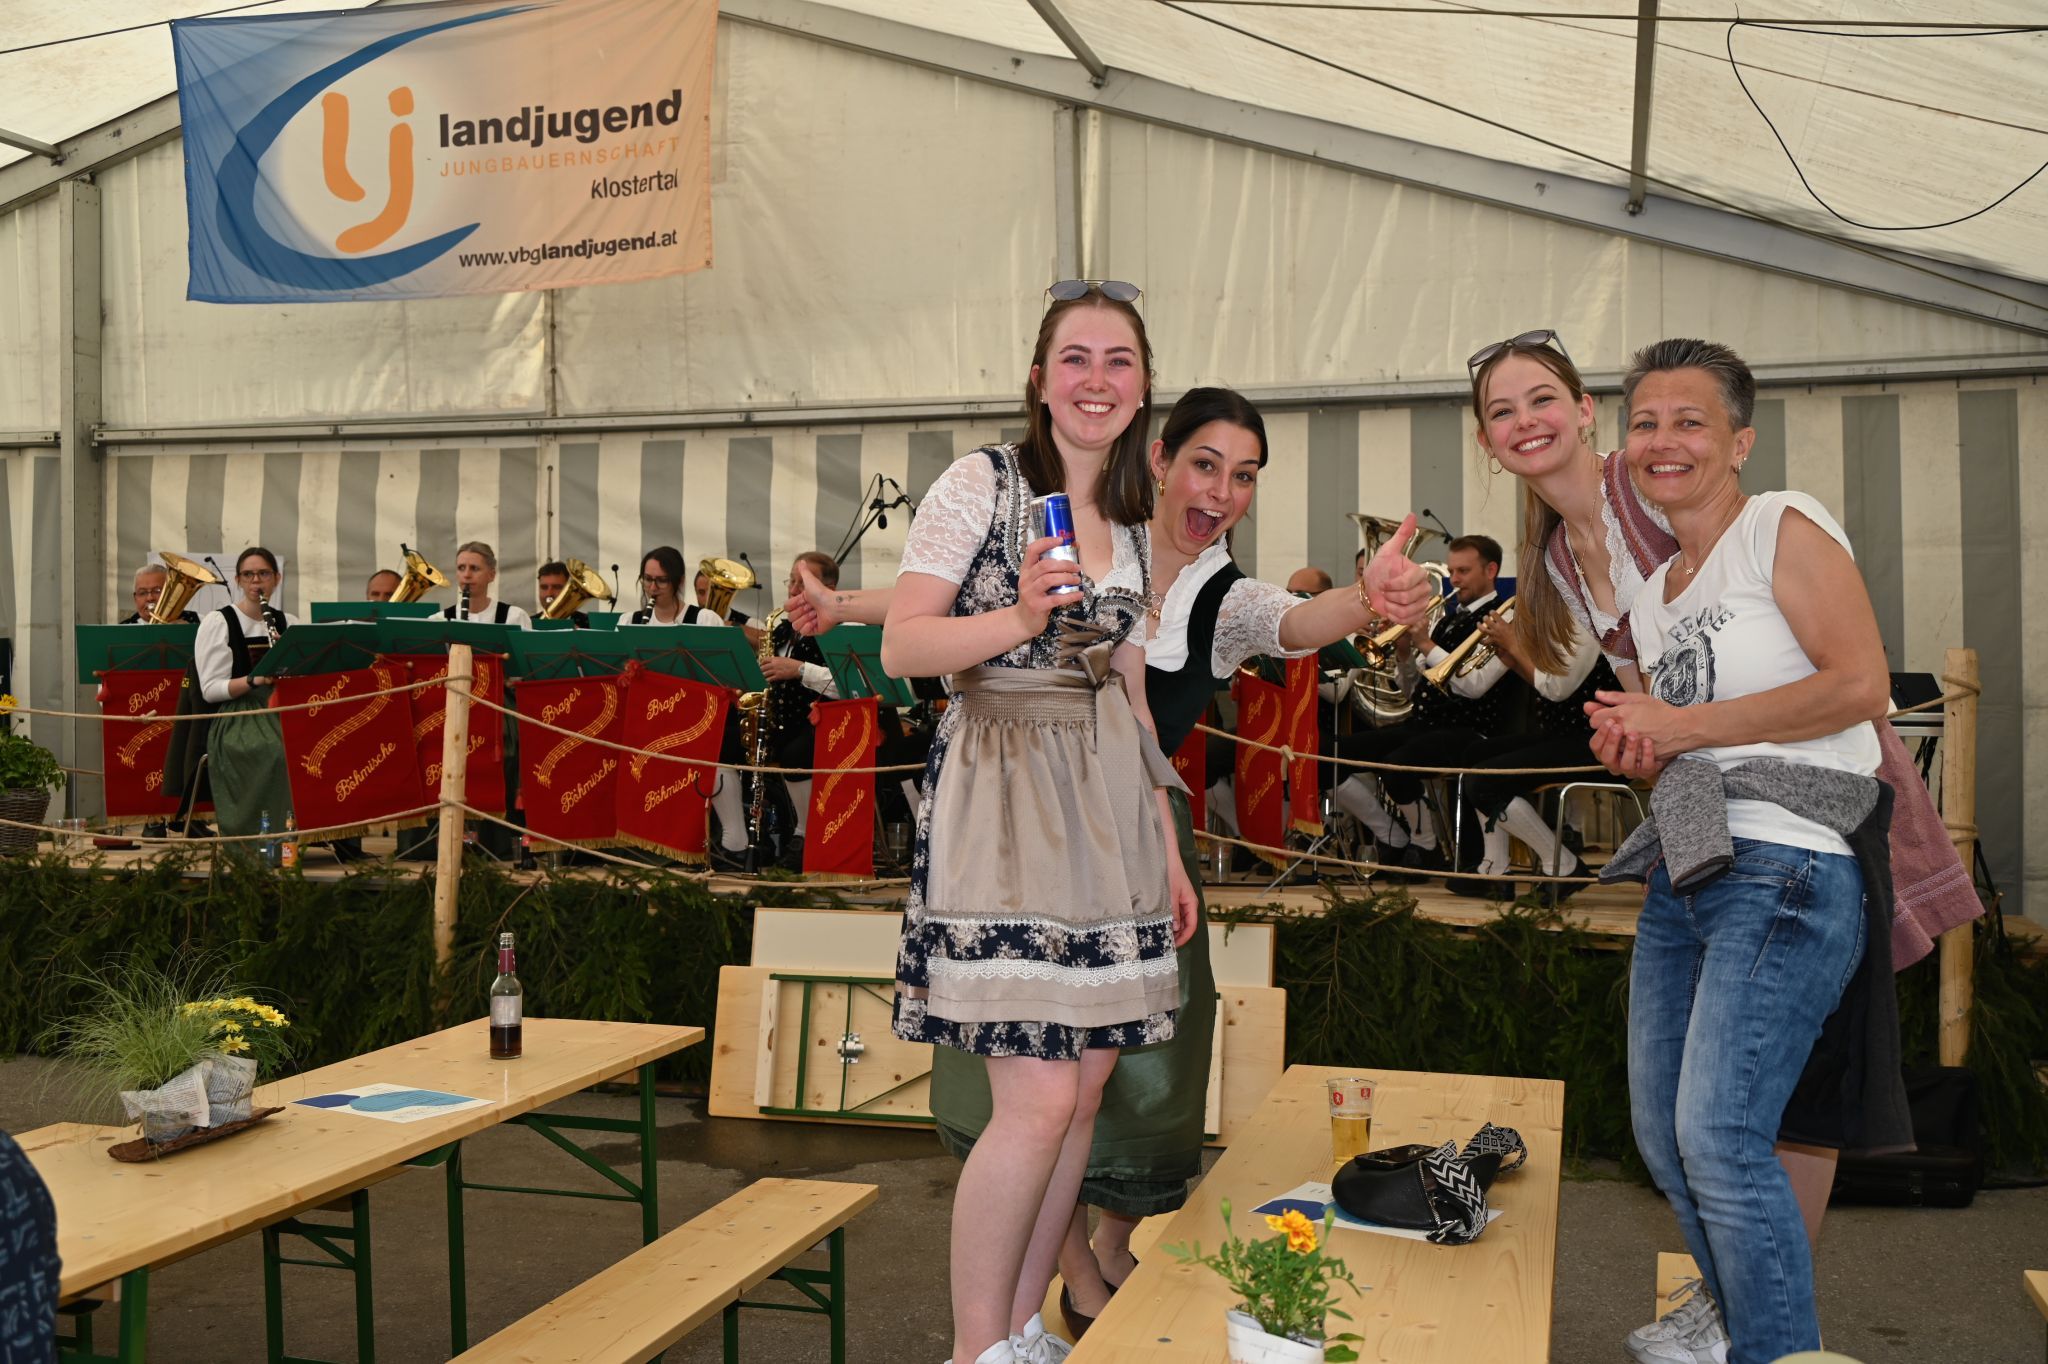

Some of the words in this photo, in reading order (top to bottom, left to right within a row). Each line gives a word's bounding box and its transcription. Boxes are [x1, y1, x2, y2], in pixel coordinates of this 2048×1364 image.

[439, 89, 682, 147] landjugend
[440, 137, 680, 177] JUNGBAUERNSCHAFT
[459, 229, 678, 267] www.vbglandjugend.at
[128, 678, 171, 713] Brazer
[307, 674, 350, 717] Brazer
[541, 687, 581, 726] Brazer
[646, 688, 686, 721] Brazer
[335, 742, 397, 802] Böhmische
[560, 758, 617, 814] Böhmische
